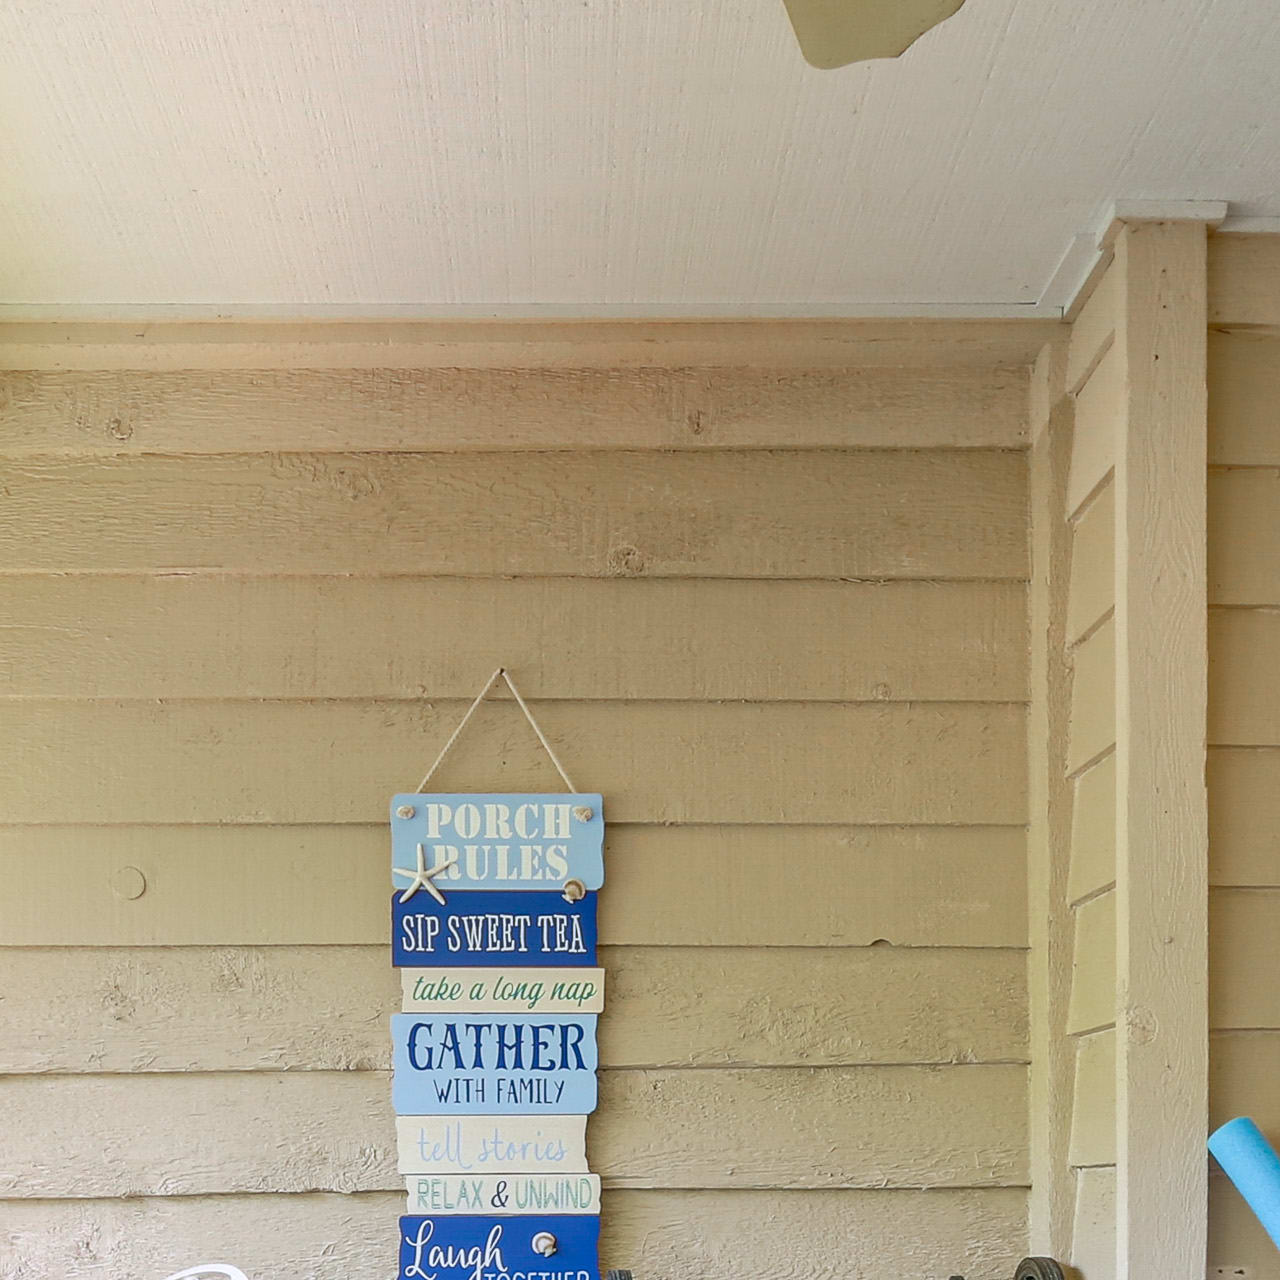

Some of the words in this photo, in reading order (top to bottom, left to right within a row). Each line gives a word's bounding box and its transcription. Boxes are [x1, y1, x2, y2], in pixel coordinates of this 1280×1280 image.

[425, 803, 572, 840] PORCH
[431, 844, 568, 880] RULES
[402, 914, 440, 952] SIP
[447, 914, 531, 952] SWEET
[537, 914, 587, 954] TEA
[412, 976, 464, 1002] take
[469, 982, 486, 1002] a
[492, 976, 546, 1009] long
[550, 980, 598, 1008] nap
[407, 1022, 588, 1071] GATHER
[433, 1078, 486, 1104] WITH
[496, 1078, 565, 1105] FAMILY
[416, 1121, 472, 1169] tell
[478, 1127, 568, 1162] stories
[417, 1178, 484, 1210] RELAX
[490, 1180, 509, 1208] &
[515, 1178, 593, 1208] UNWIND
